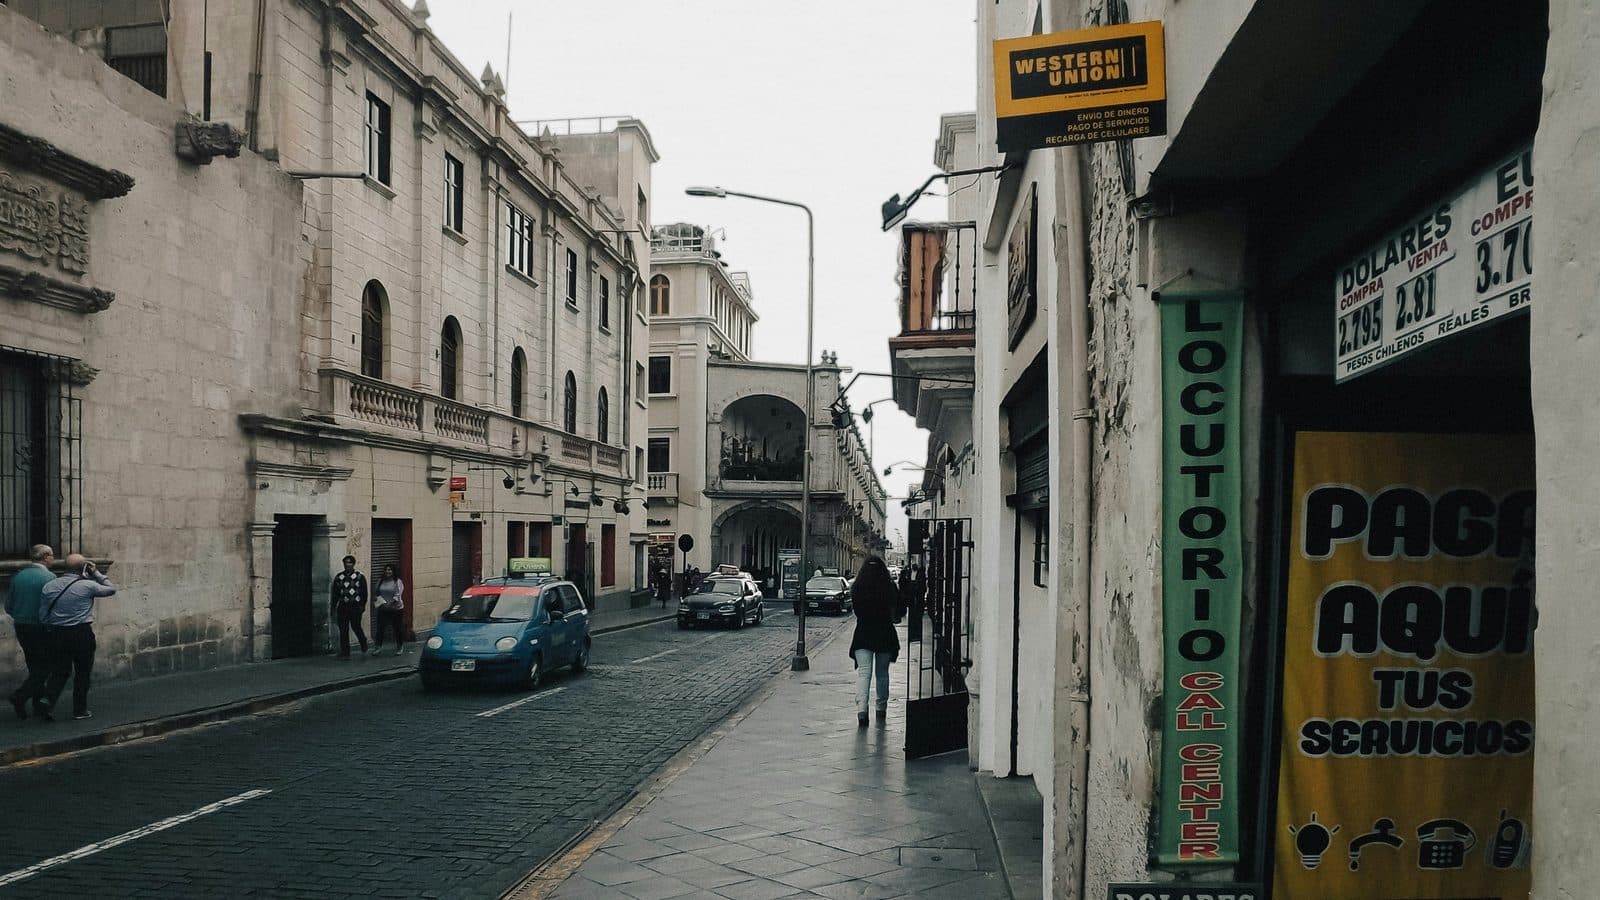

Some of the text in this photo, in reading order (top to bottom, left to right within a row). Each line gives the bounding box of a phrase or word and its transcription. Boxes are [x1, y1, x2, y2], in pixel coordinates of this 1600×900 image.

[1015, 48, 1120, 75] WESTERN
[1049, 64, 1120, 87] UNION
[1045, 126, 1150, 144] RECARGA DE CELULARES
[1067, 117, 1150, 132] PAGO DE SERVICIOS
[1077, 106, 1149, 122] ENVIO DE DINERO
[1340, 238, 1449, 311] COMPRA VENTA
[1342, 205, 1452, 296] DOLARES
[1338, 300, 1382, 357] 2.795
[1396, 269, 1436, 331] 2.81
[1346, 288, 1531, 372] PESOS CHILENOS REALES BR
[1178, 300, 1227, 662] LOCUTORIO
[1175, 671, 1227, 731] CALL
[1372, 667, 1474, 712] TUS
[1298, 718, 1535, 758] SERVICIOS
[1178, 743, 1225, 861] CENTER
